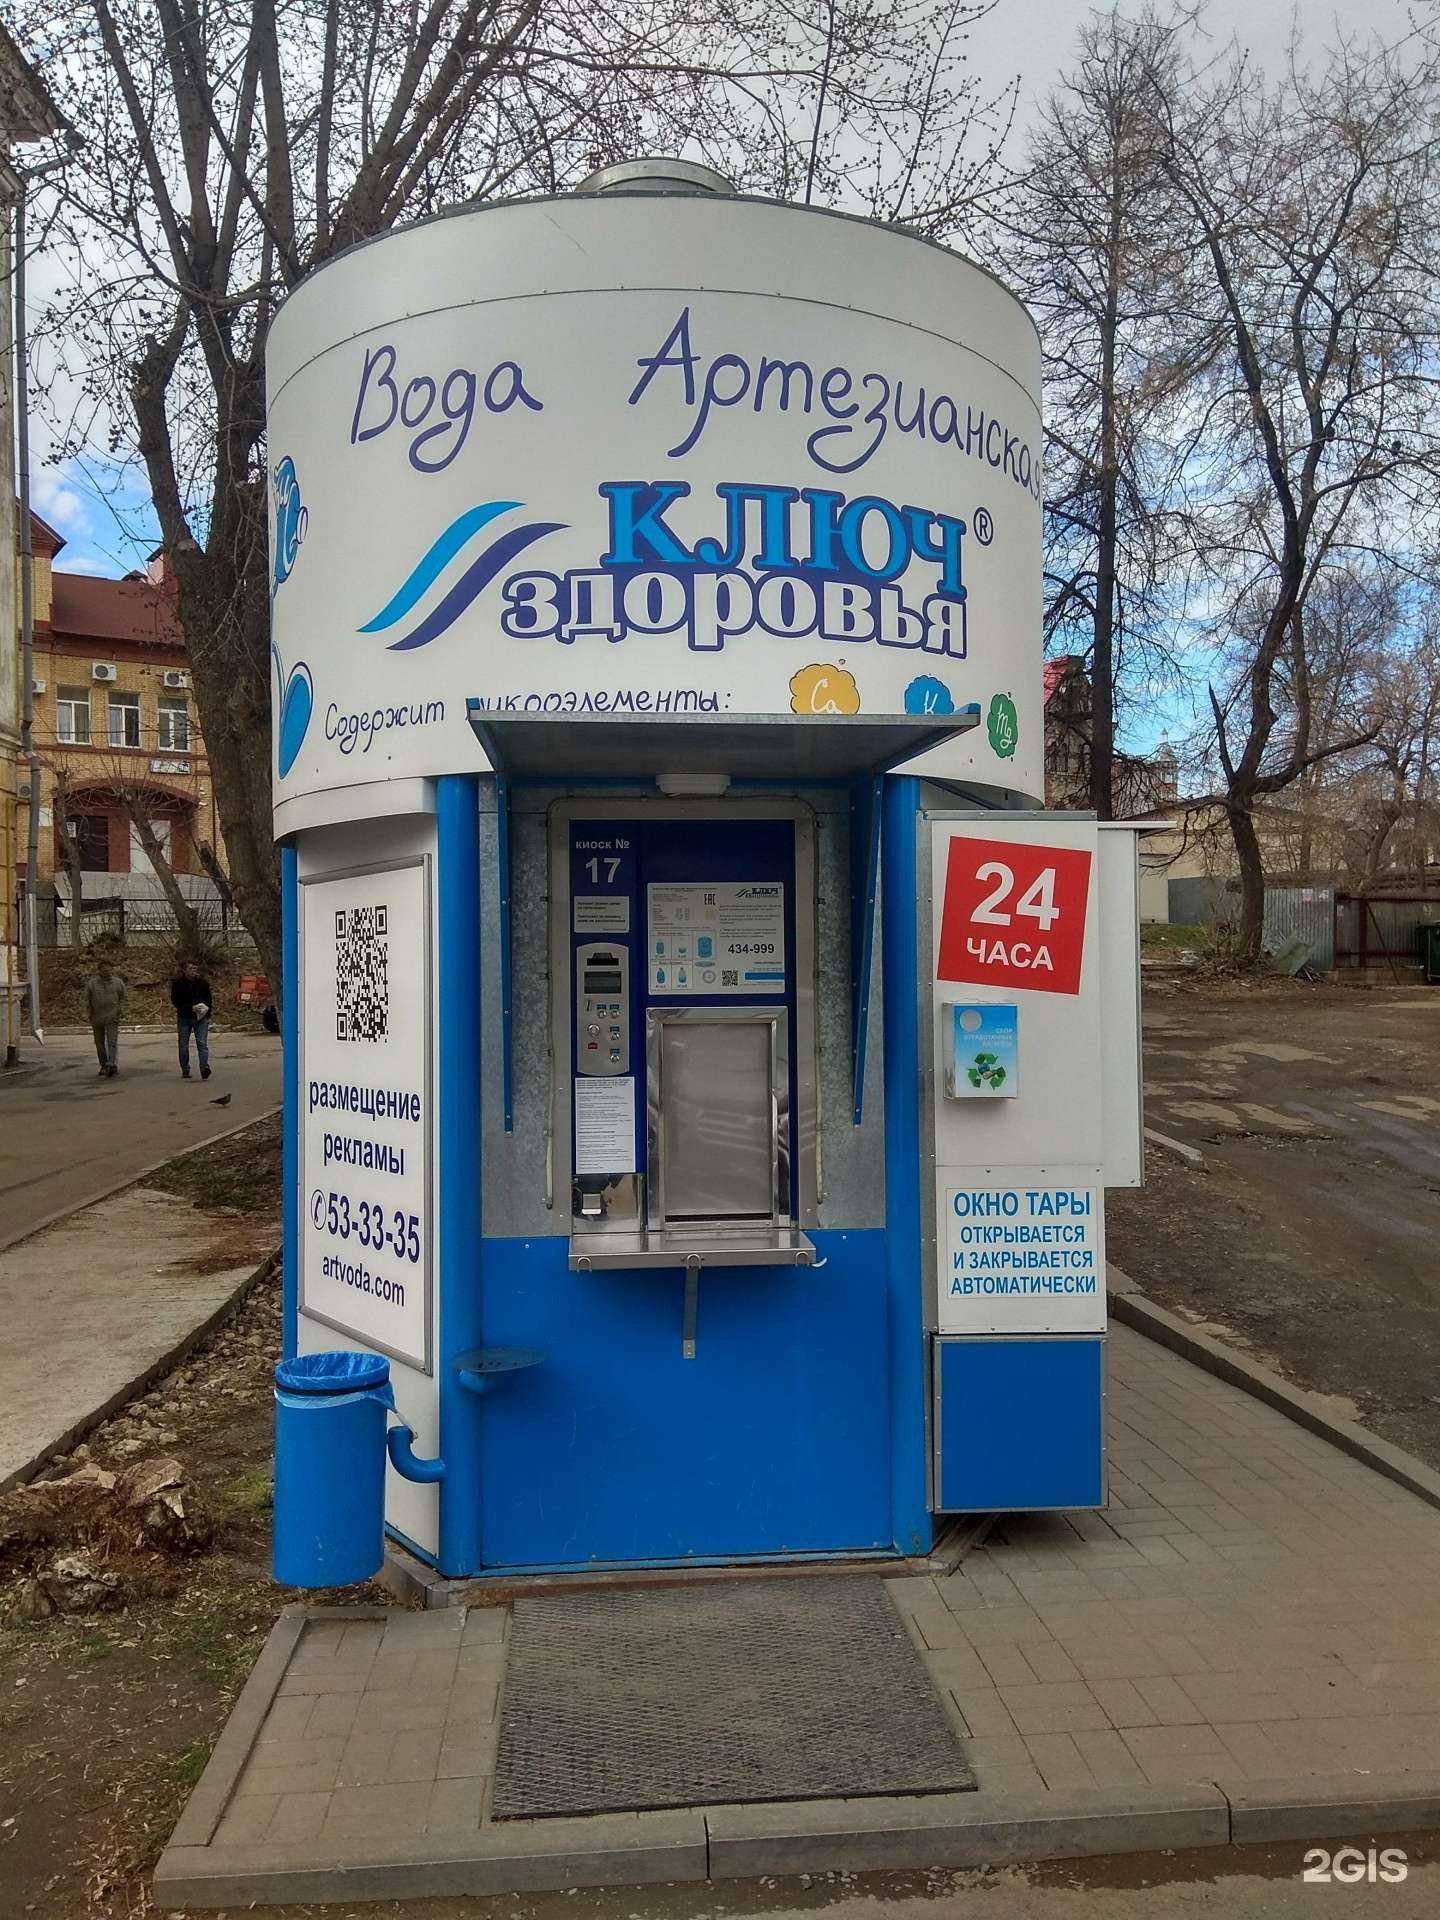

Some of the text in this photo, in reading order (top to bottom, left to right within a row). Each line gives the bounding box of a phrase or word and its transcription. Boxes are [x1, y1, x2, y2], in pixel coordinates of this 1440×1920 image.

[351, 305, 1040, 509] Вода Артезианская
[599, 481, 968, 599] КЛЮЧ
[502, 568, 968, 660] здоровья
[325, 690, 734, 754] Содержит икоэлементы:
[615, 838, 630, 849] №
[585, 857, 621, 883] 17
[970, 861, 1060, 931] 24
[728, 943, 775, 954] 434-999
[967, 937, 1054, 971] ЧАСА
[309, 1079, 421, 1123] размещение
[323, 1132, 405, 1176] рекламы
[953, 1191, 1091, 1217] ОКНО ТАРЫ
[327, 1192, 420, 1264] 53-33-35
[960, 1225, 1085, 1244] ОТКРЫВАЕТСЯ
[322, 1253, 405, 1307] artvoda.com
[953, 1250, 1093, 1270] И ЗАКРЫВАЕТСЯ
[950, 1275, 1097, 1296] АВТОМАТИЧЕСКИ
